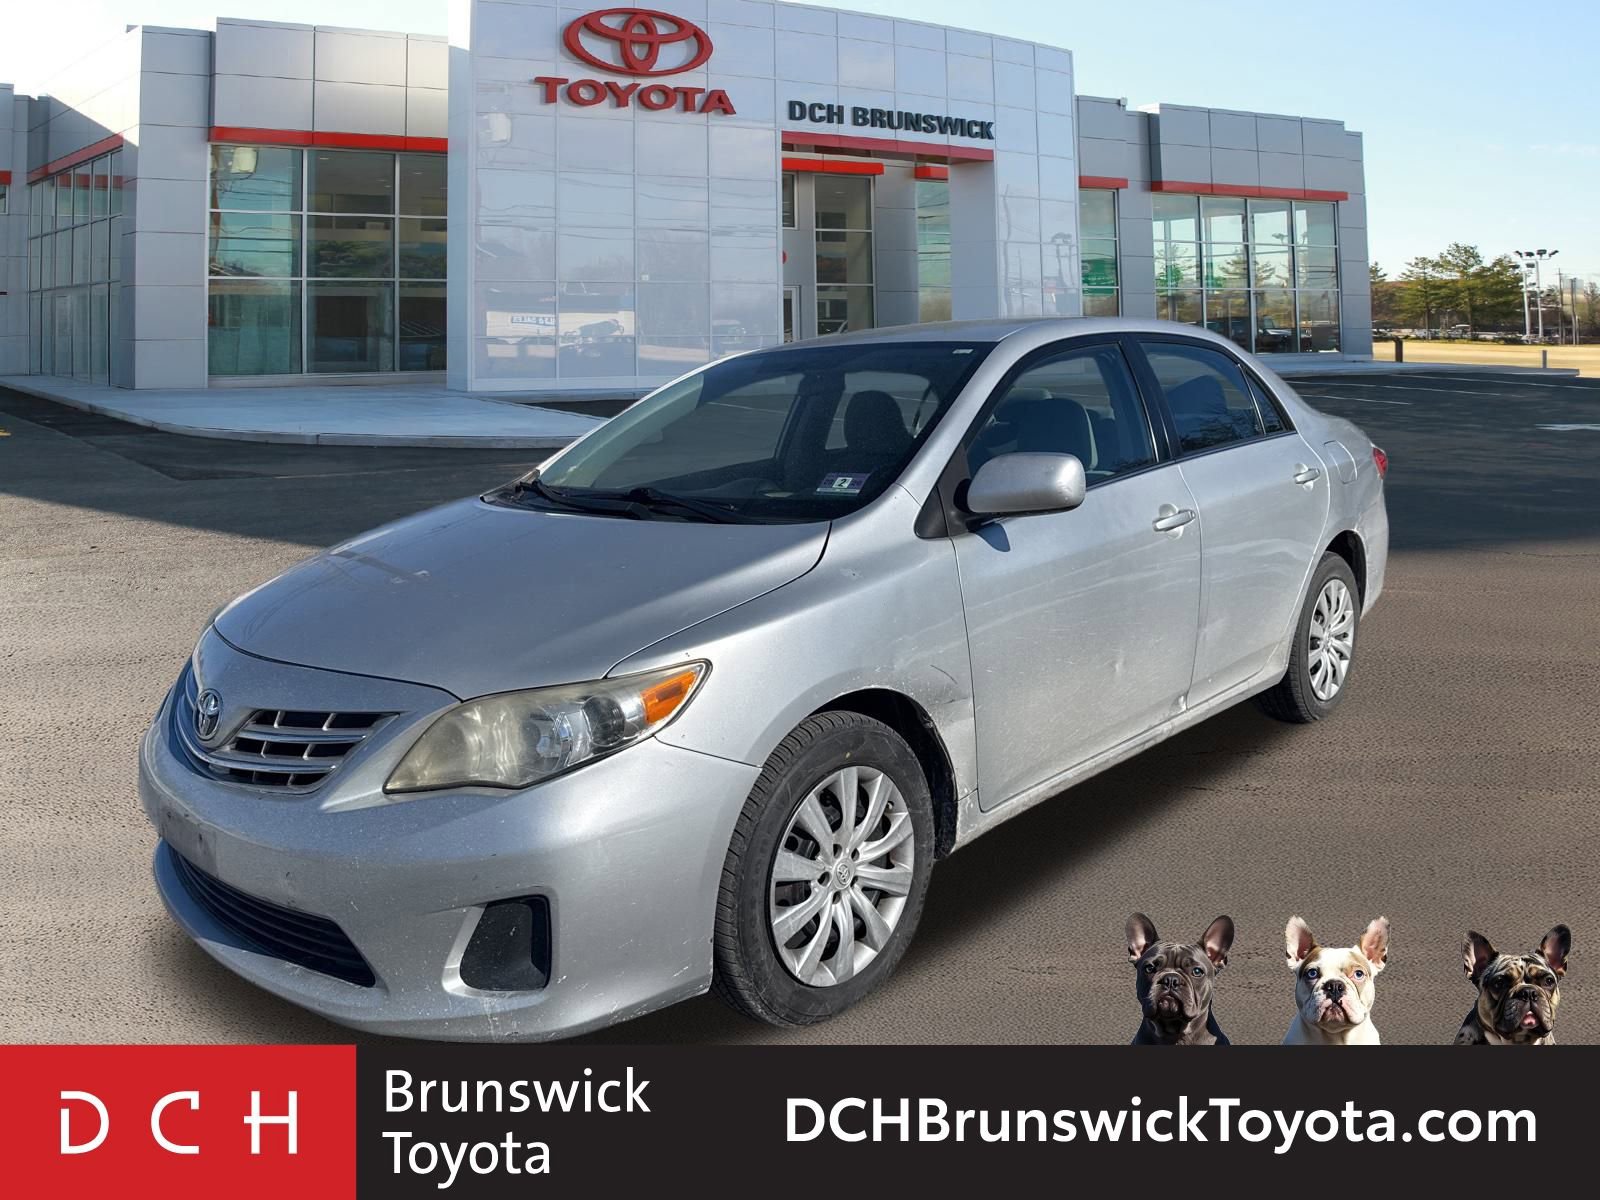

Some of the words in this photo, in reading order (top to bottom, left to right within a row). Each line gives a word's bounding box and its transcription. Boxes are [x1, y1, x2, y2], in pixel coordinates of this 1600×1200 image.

[534, 76, 736, 115] TOYOTA
[788, 100, 845, 125] DCH
[852, 106, 995, 140] BRUNSWICK
